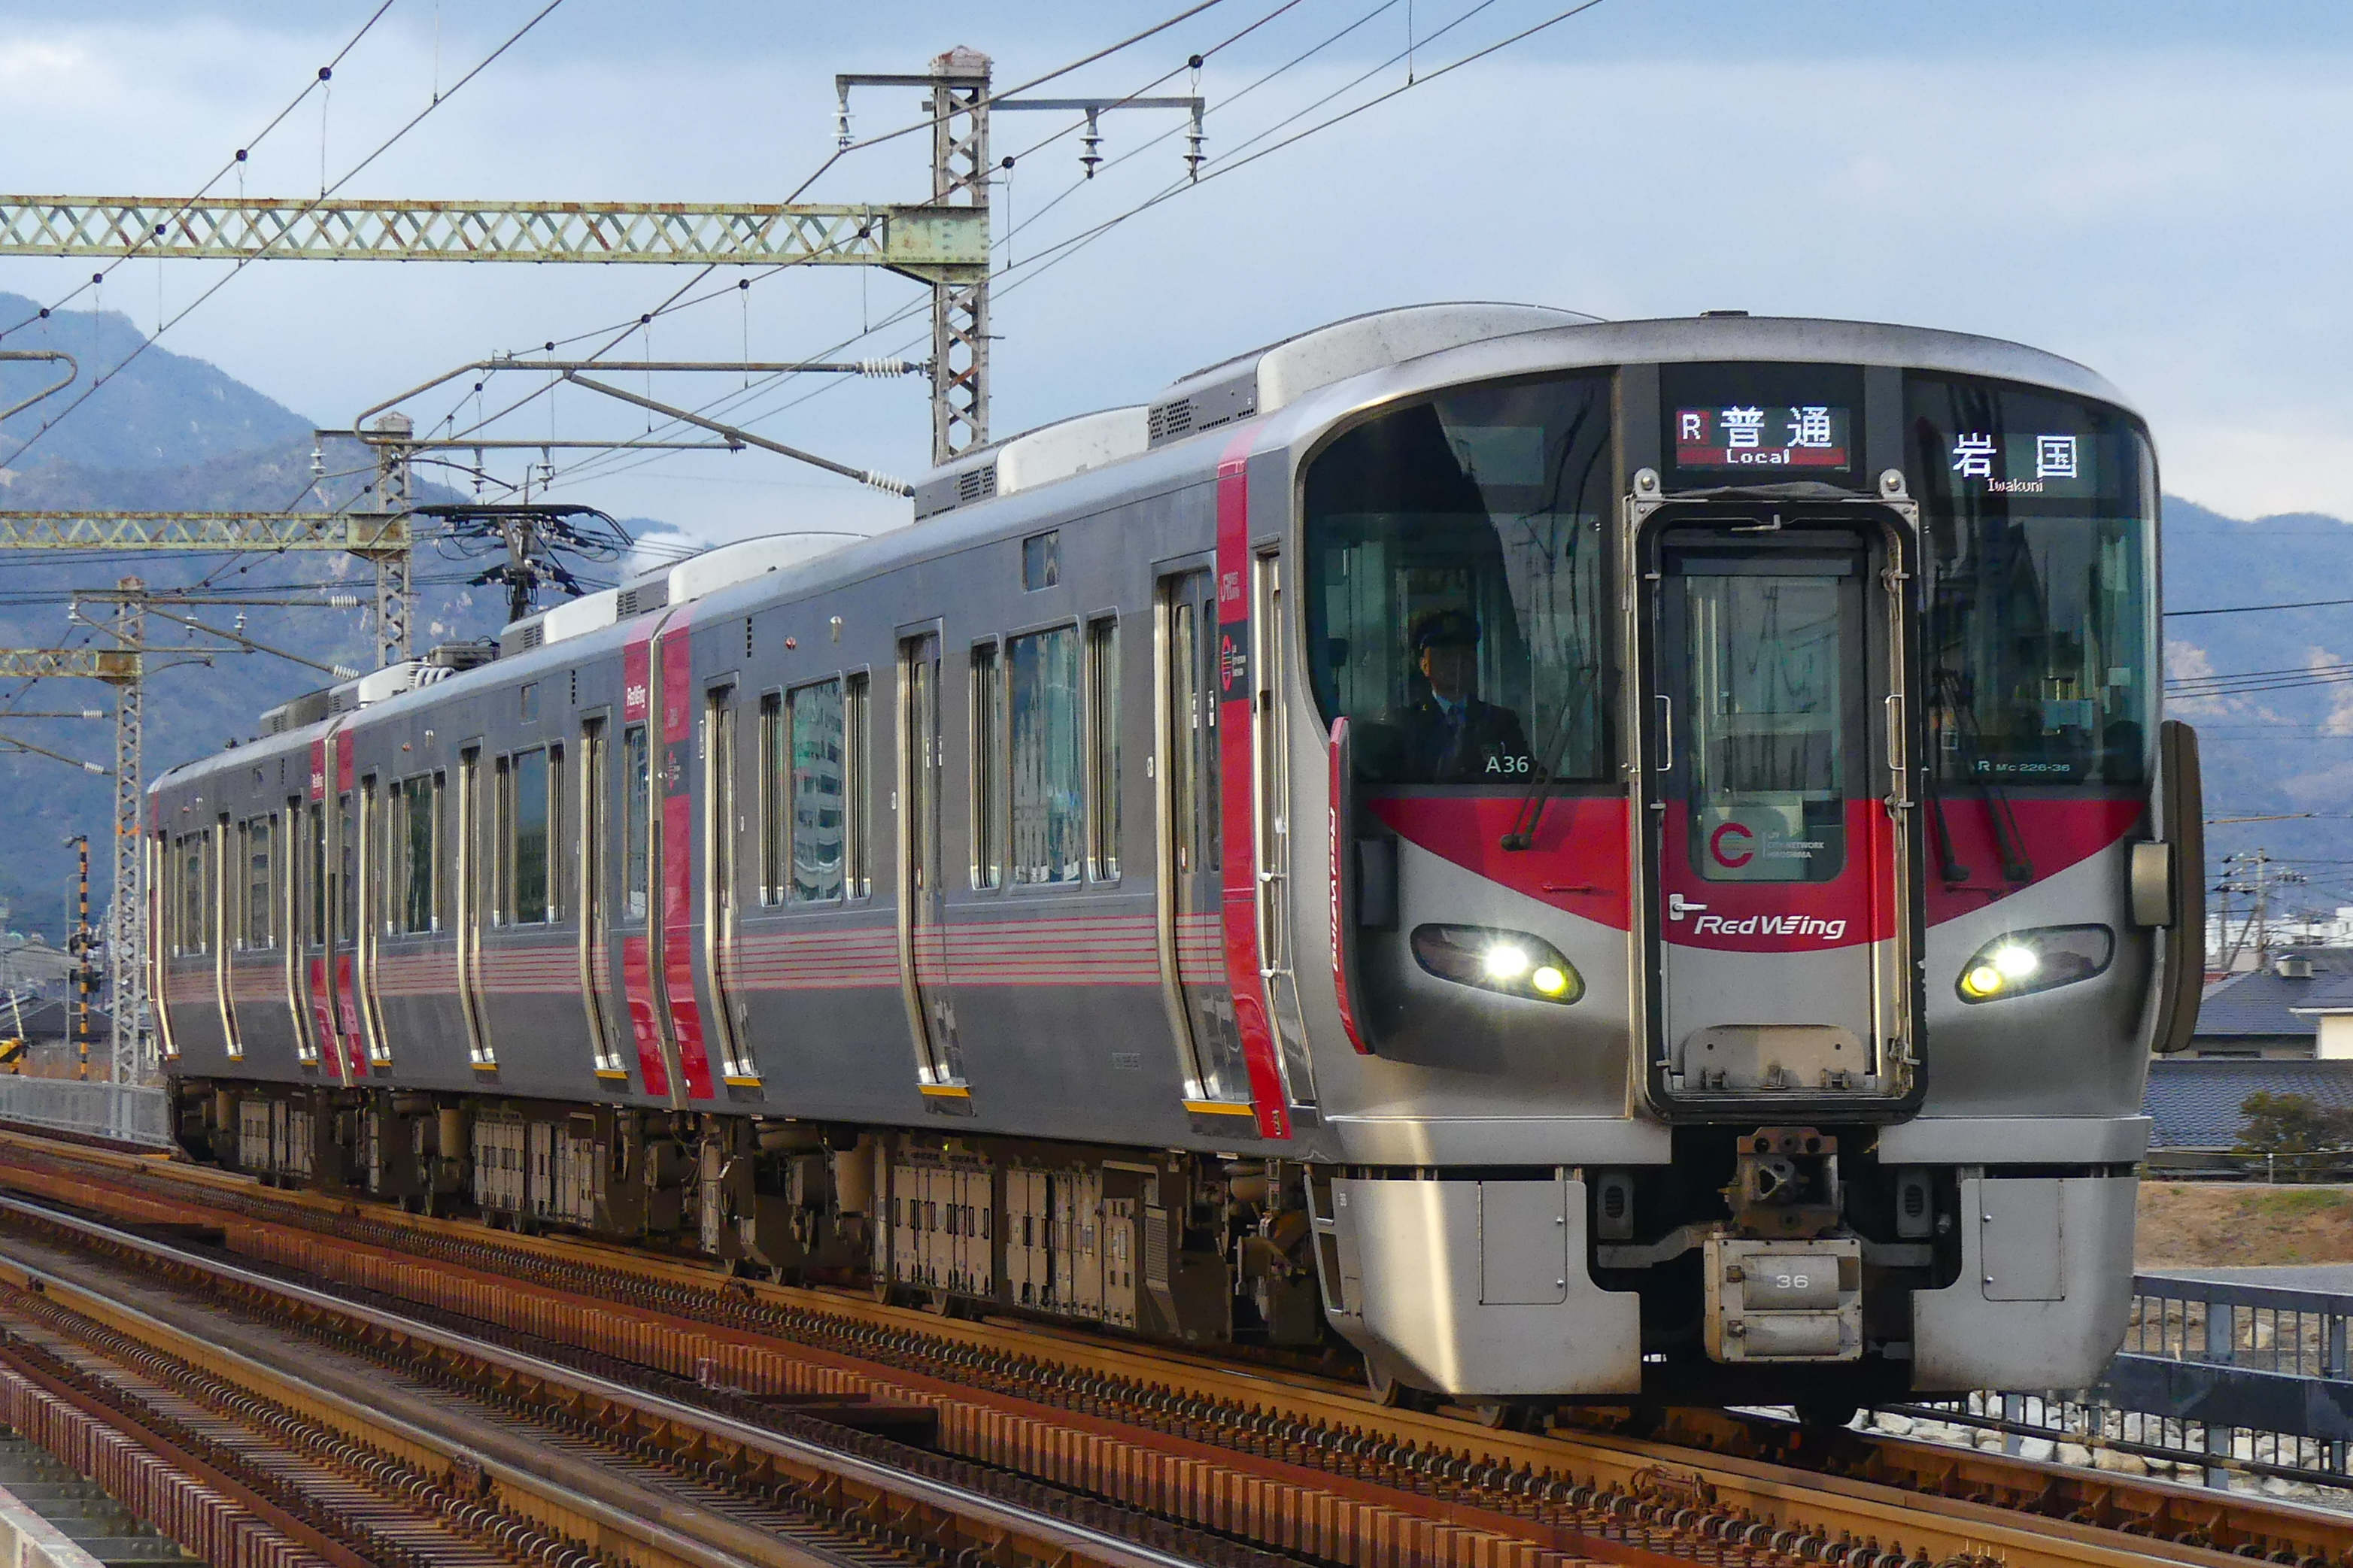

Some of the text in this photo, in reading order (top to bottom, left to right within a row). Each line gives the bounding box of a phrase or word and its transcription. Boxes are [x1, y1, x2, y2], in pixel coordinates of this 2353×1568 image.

[1682, 413, 1702, 441] R
[1720, 405, 1833, 448] 普通
[1726, 448, 1791, 465] Local
[1952, 432, 2078, 478] 岩国
[1987, 478, 2045, 493] Iwakuni
[1484, 755, 1530, 774] A36
[1693, 915, 1847, 940] RedWing
[1776, 1275, 1809, 1289] 36
